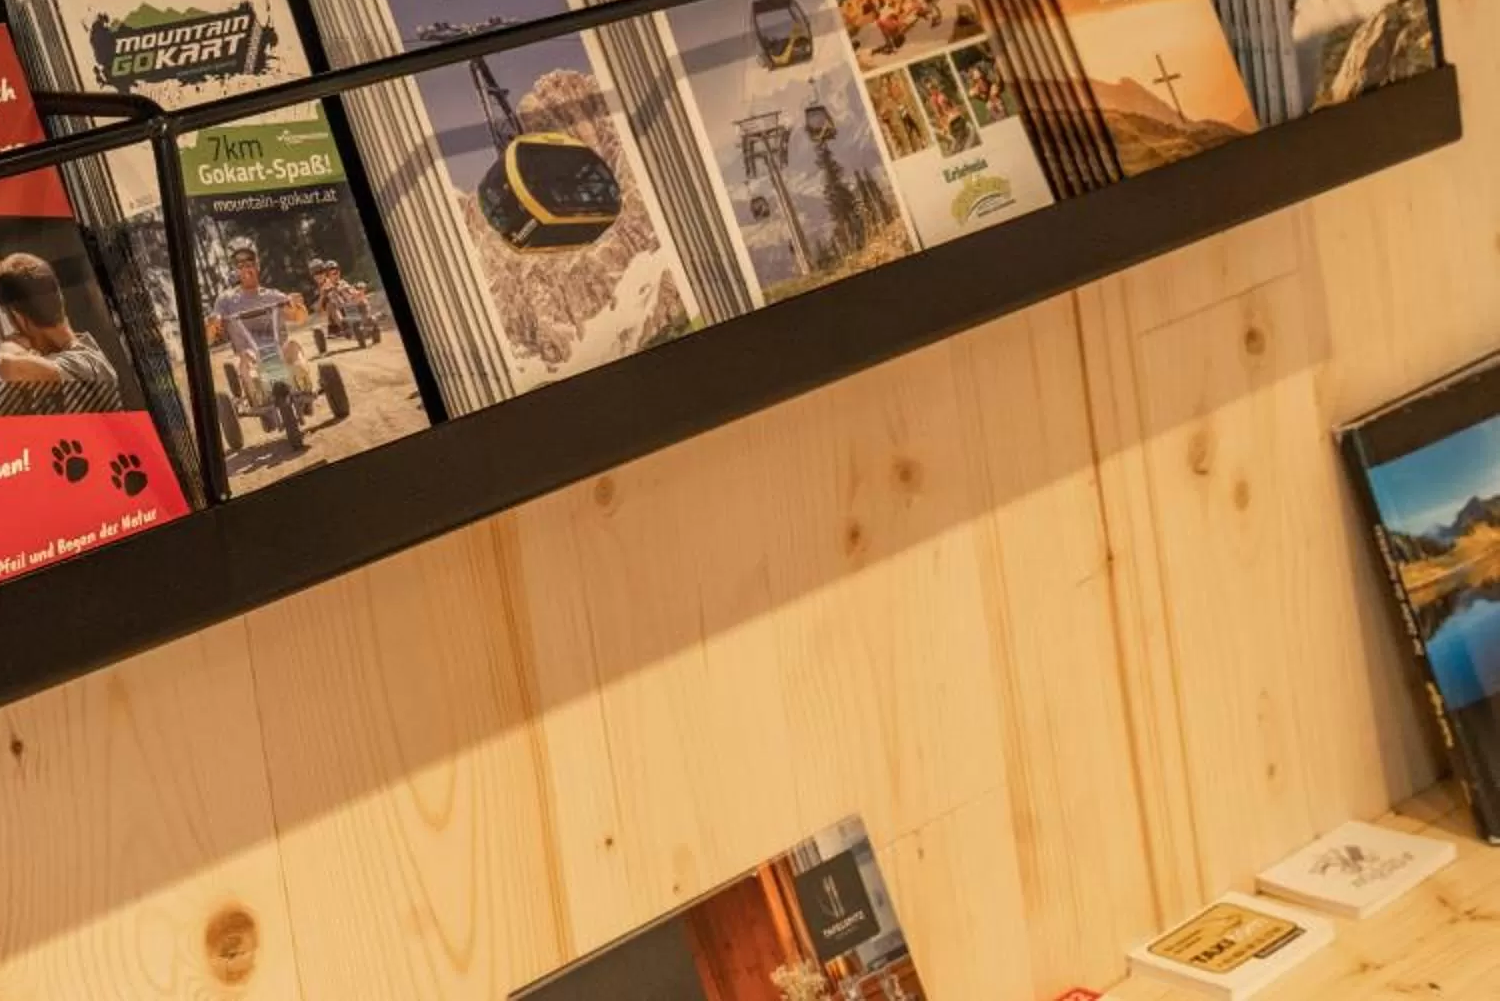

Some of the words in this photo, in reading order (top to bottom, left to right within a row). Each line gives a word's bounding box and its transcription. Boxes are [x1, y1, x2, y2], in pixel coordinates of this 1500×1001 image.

[197, 152, 334, 185] Gokart-Spaß!
[213, 188, 338, 213] mountain-gokart.at
[29, 540, 55, 564] und
[57, 531, 97, 555] Bogen
[99, 520, 120, 540] der
[121, 508, 158, 529] Natur
[1189, 938, 1237, 965] TAXI
